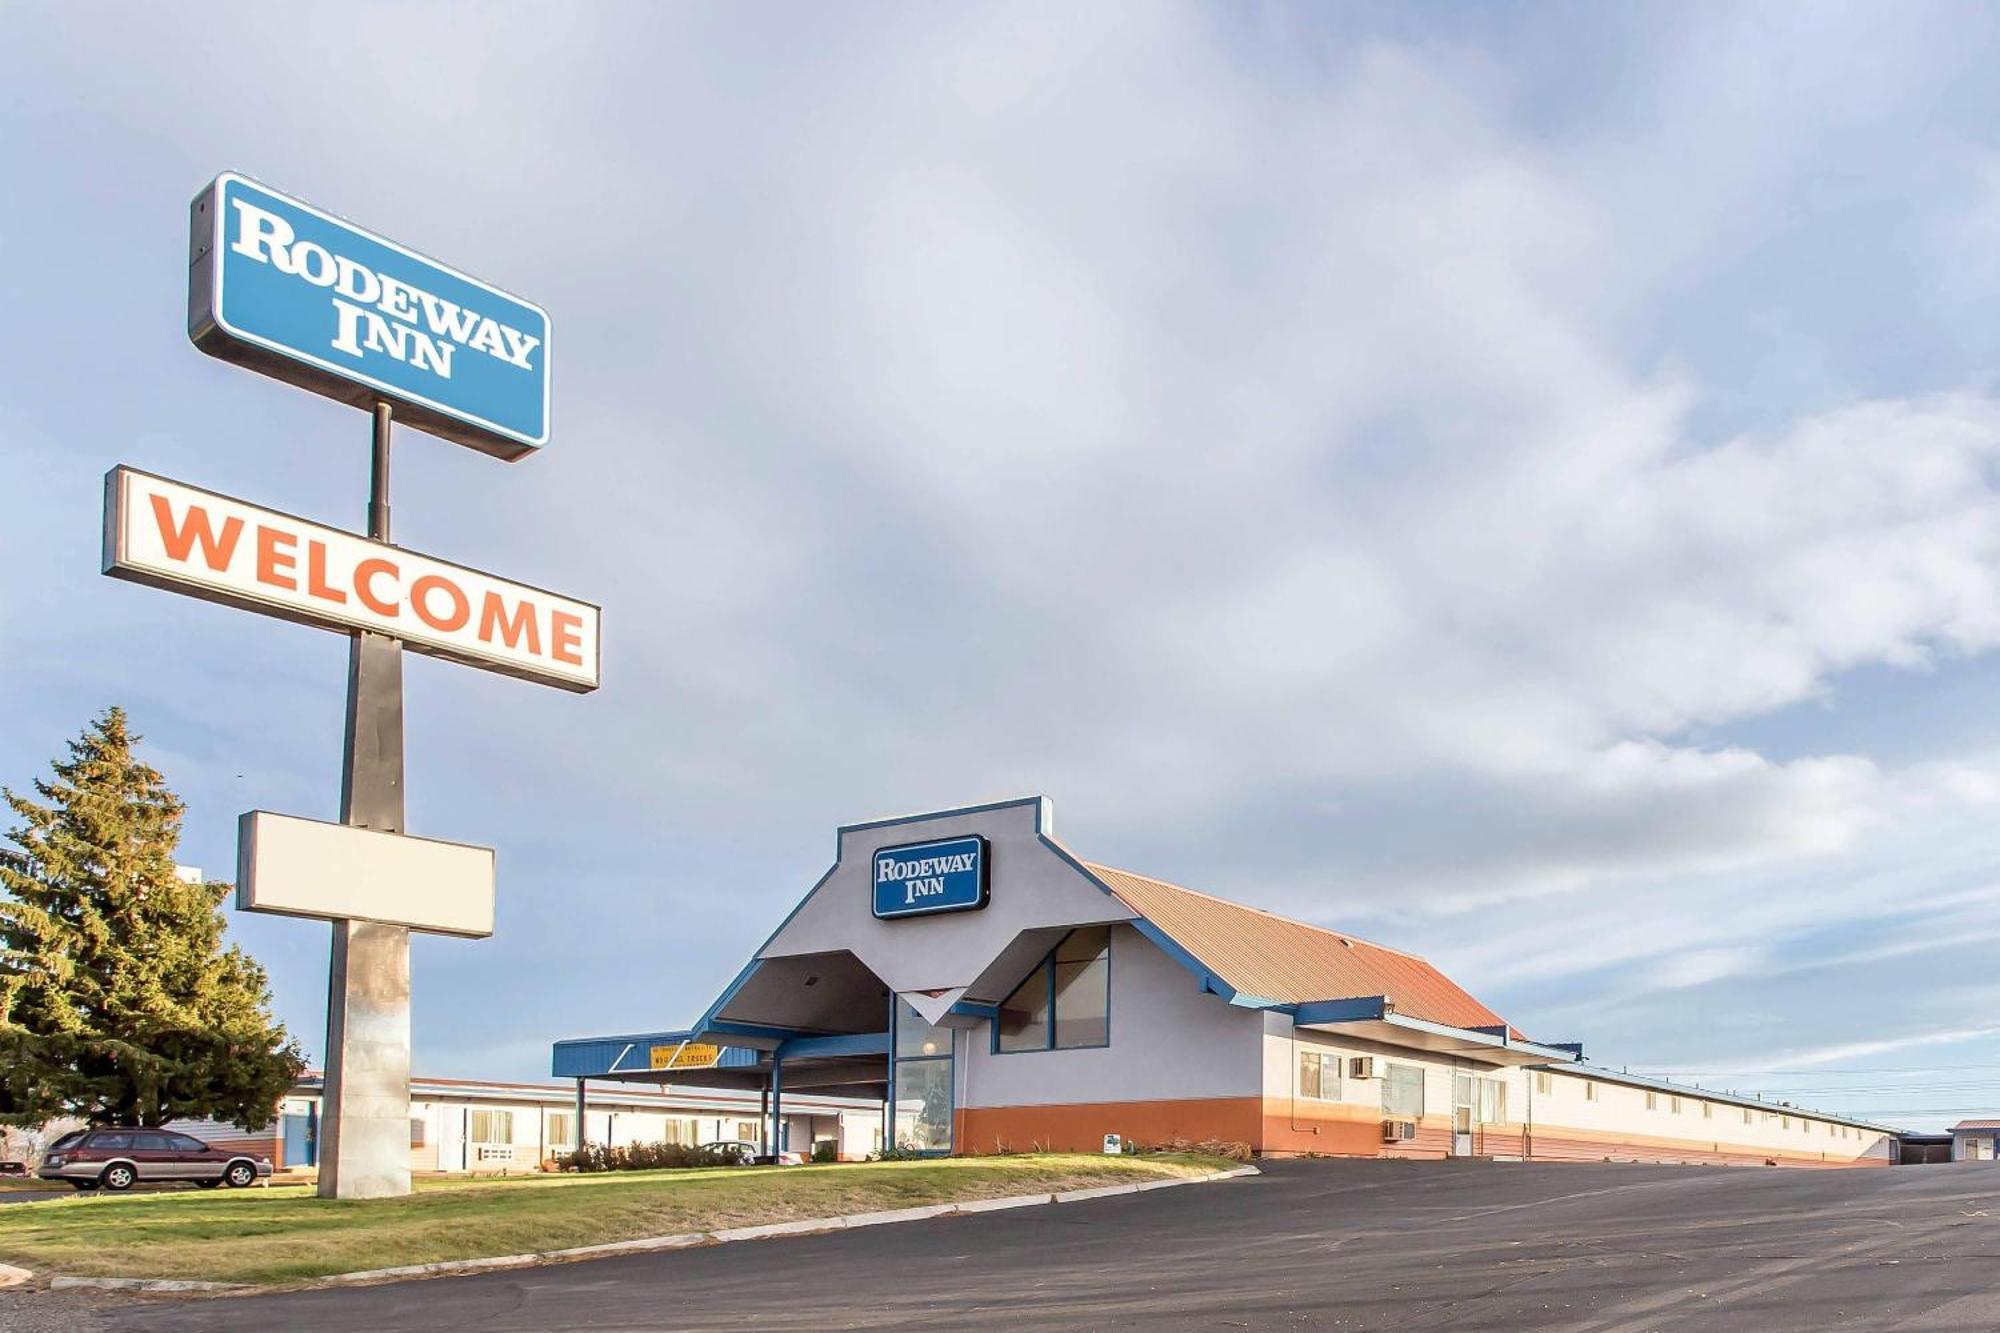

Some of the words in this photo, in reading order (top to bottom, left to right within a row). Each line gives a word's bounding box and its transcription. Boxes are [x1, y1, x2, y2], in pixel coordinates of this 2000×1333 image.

[231, 197, 540, 371] RODEWAY
[331, 298, 456, 379] INN
[149, 494, 582, 667] WELCOME
[878, 853, 976, 882] RODEWAY
[905, 877, 945, 904] INN
